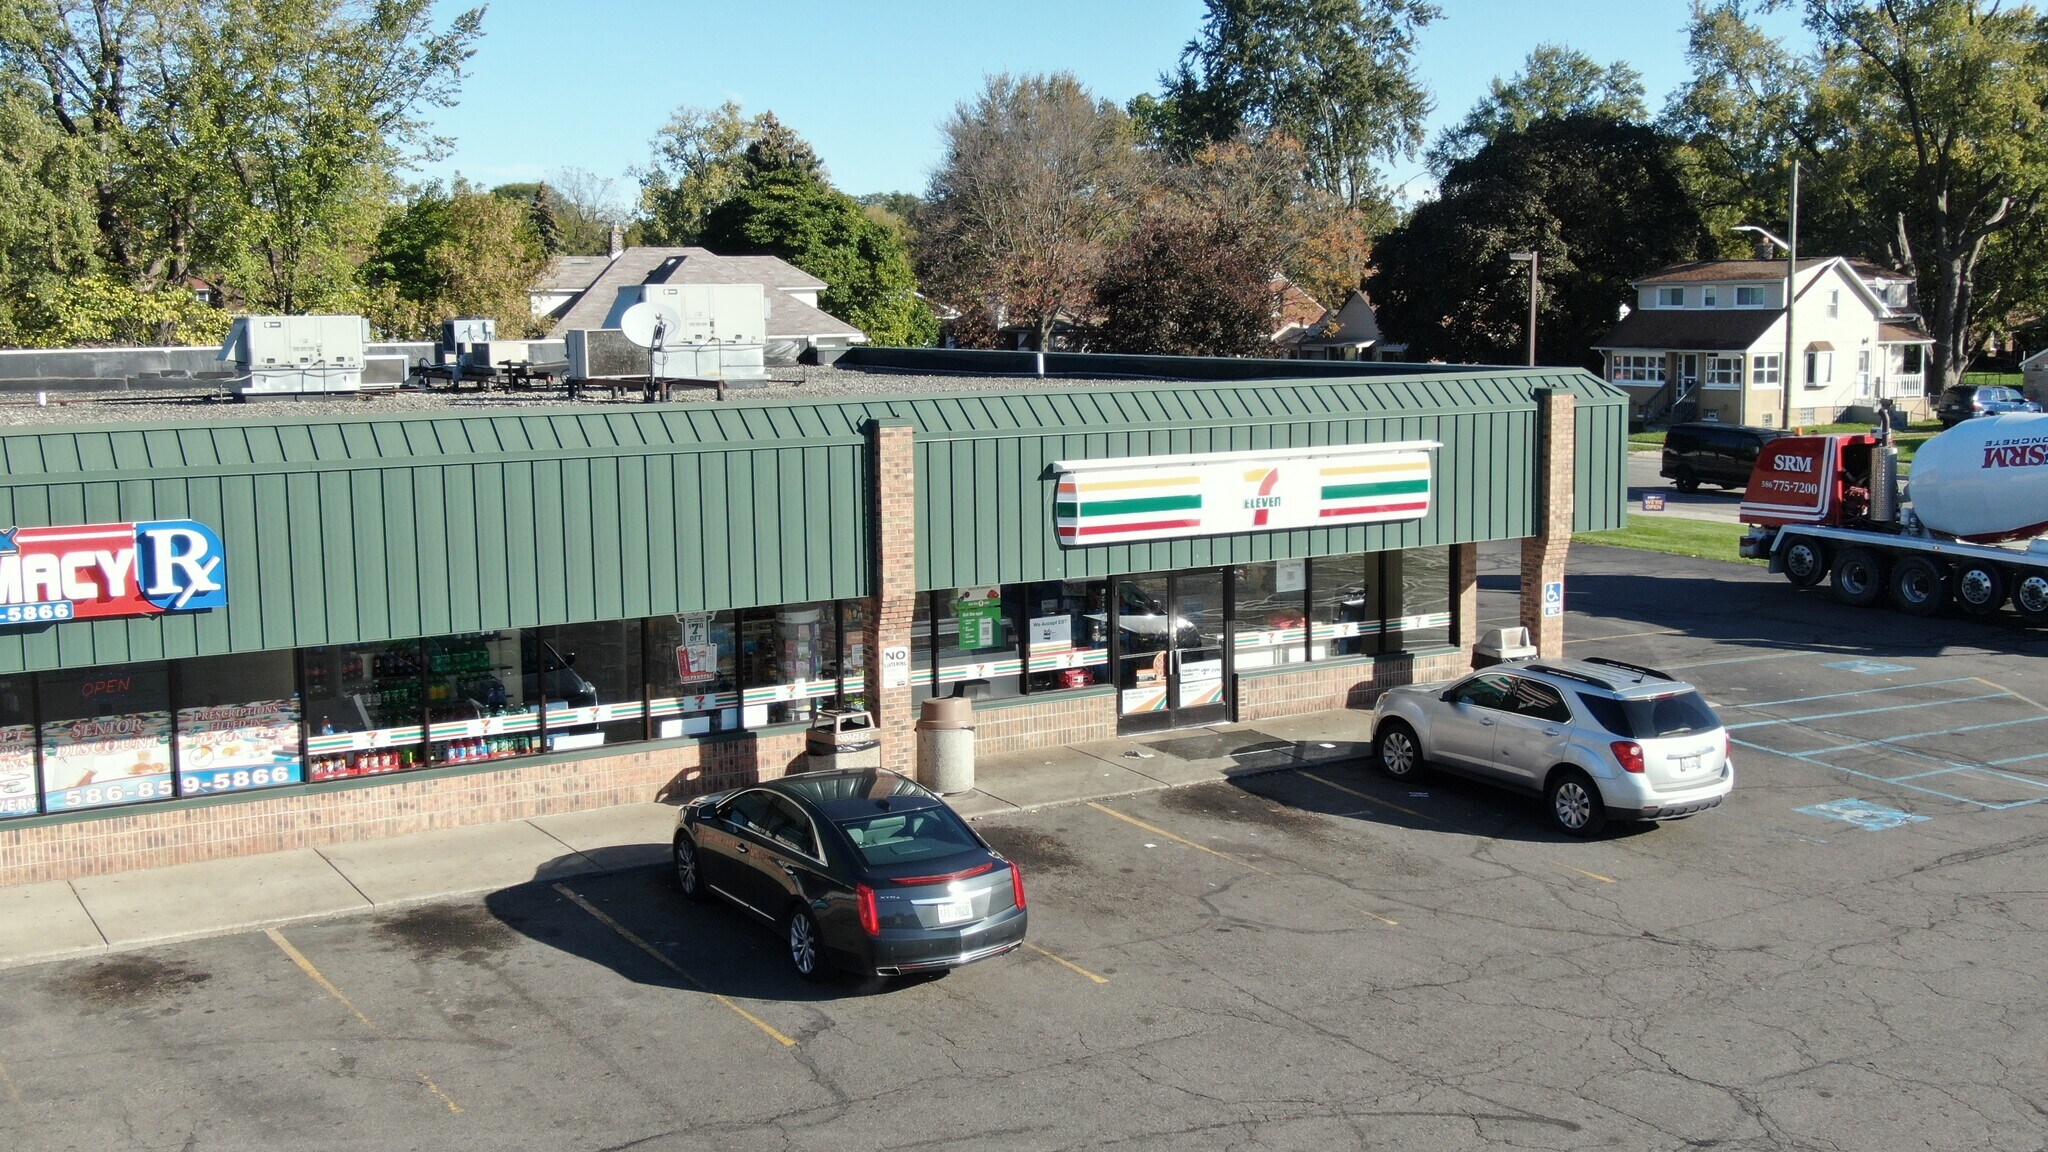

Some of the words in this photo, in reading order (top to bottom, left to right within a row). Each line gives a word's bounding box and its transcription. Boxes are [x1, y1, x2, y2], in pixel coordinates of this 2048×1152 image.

[1773, 454, 1813, 473] SRM
[1981, 444, 2046, 468] SRM
[1773, 480, 1818, 494] 775-7200
[885, 650, 906, 660] NO
[82, 676, 131, 697] OPEN
[194, 705, 279, 721] PRESCRIPTIONS
[71, 718, 143, 738] SENIOR
[211, 727, 286, 744] MINUTES
[55, 735, 160, 758] DISCOUNT
